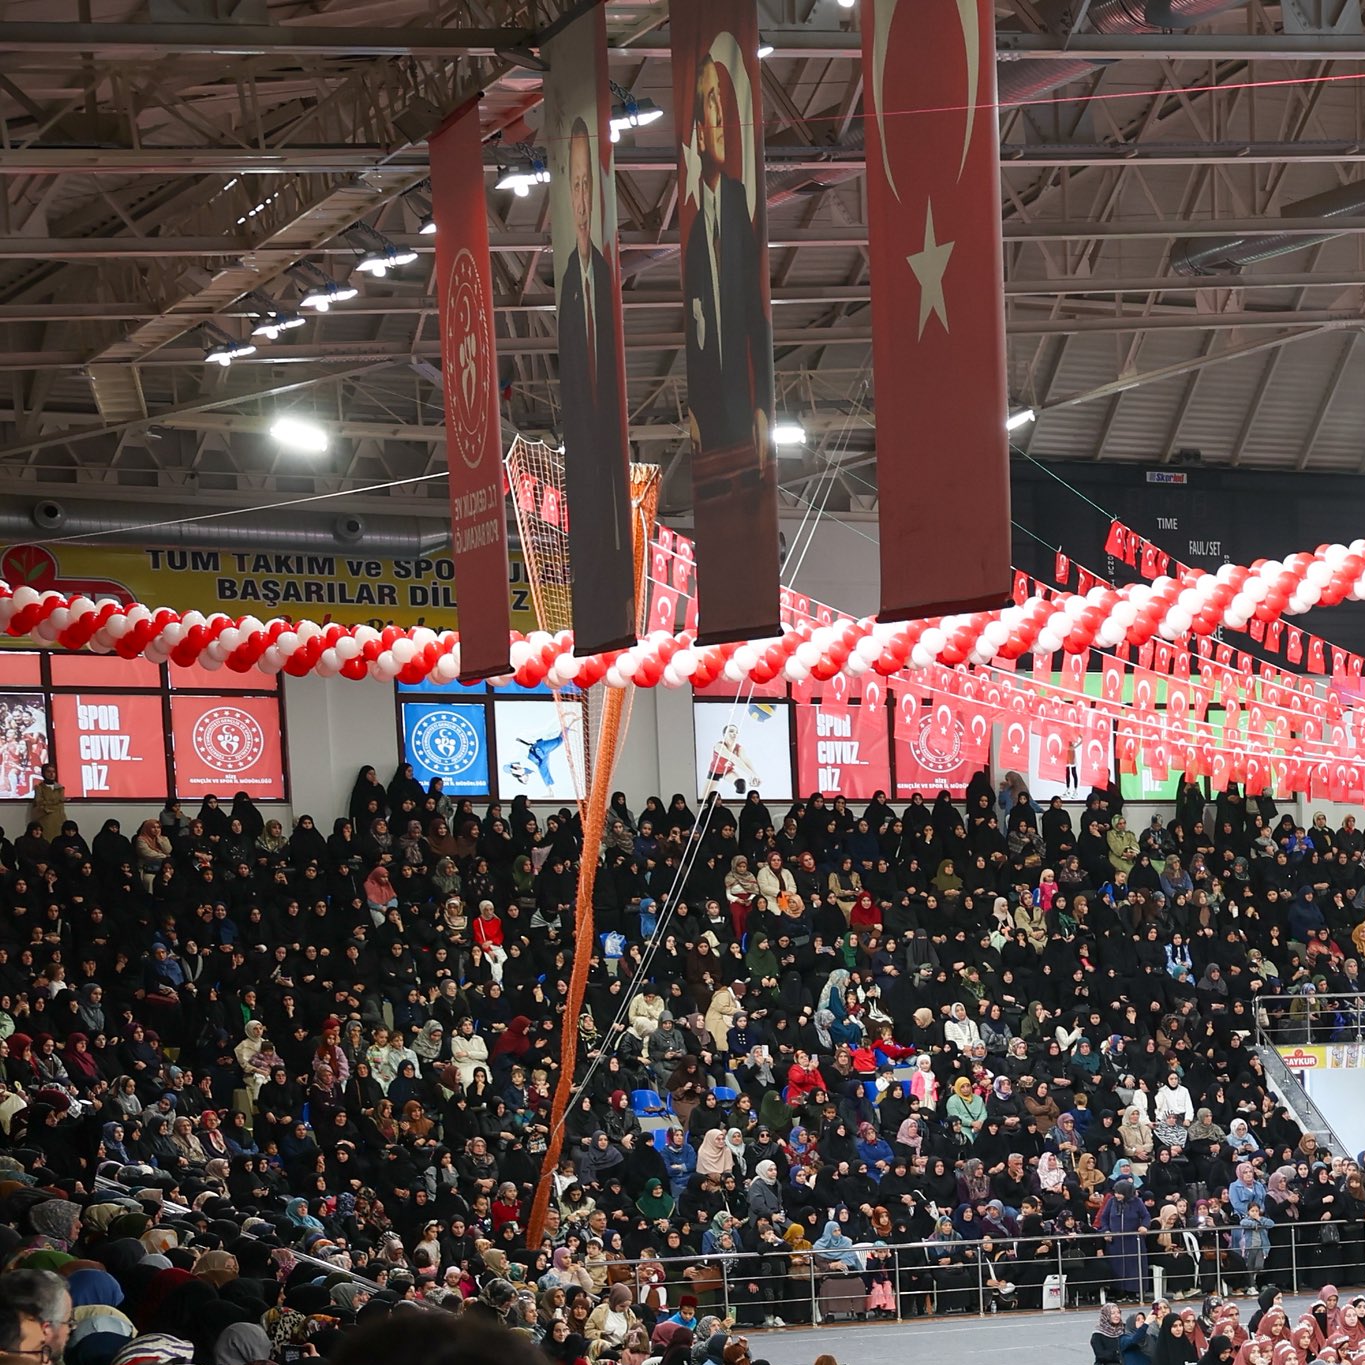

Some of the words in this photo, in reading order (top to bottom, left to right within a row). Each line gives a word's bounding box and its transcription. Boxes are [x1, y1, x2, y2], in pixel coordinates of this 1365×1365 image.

[1157, 518, 1178, 530] TIME
[1189, 540, 1221, 556] FAUL/SET
[232, 553, 335, 576] TAKIM
[347, 560, 382, 577] ve
[217, 578, 398, 607] BAŞARILAR
[76, 696, 119, 730] SPOR
